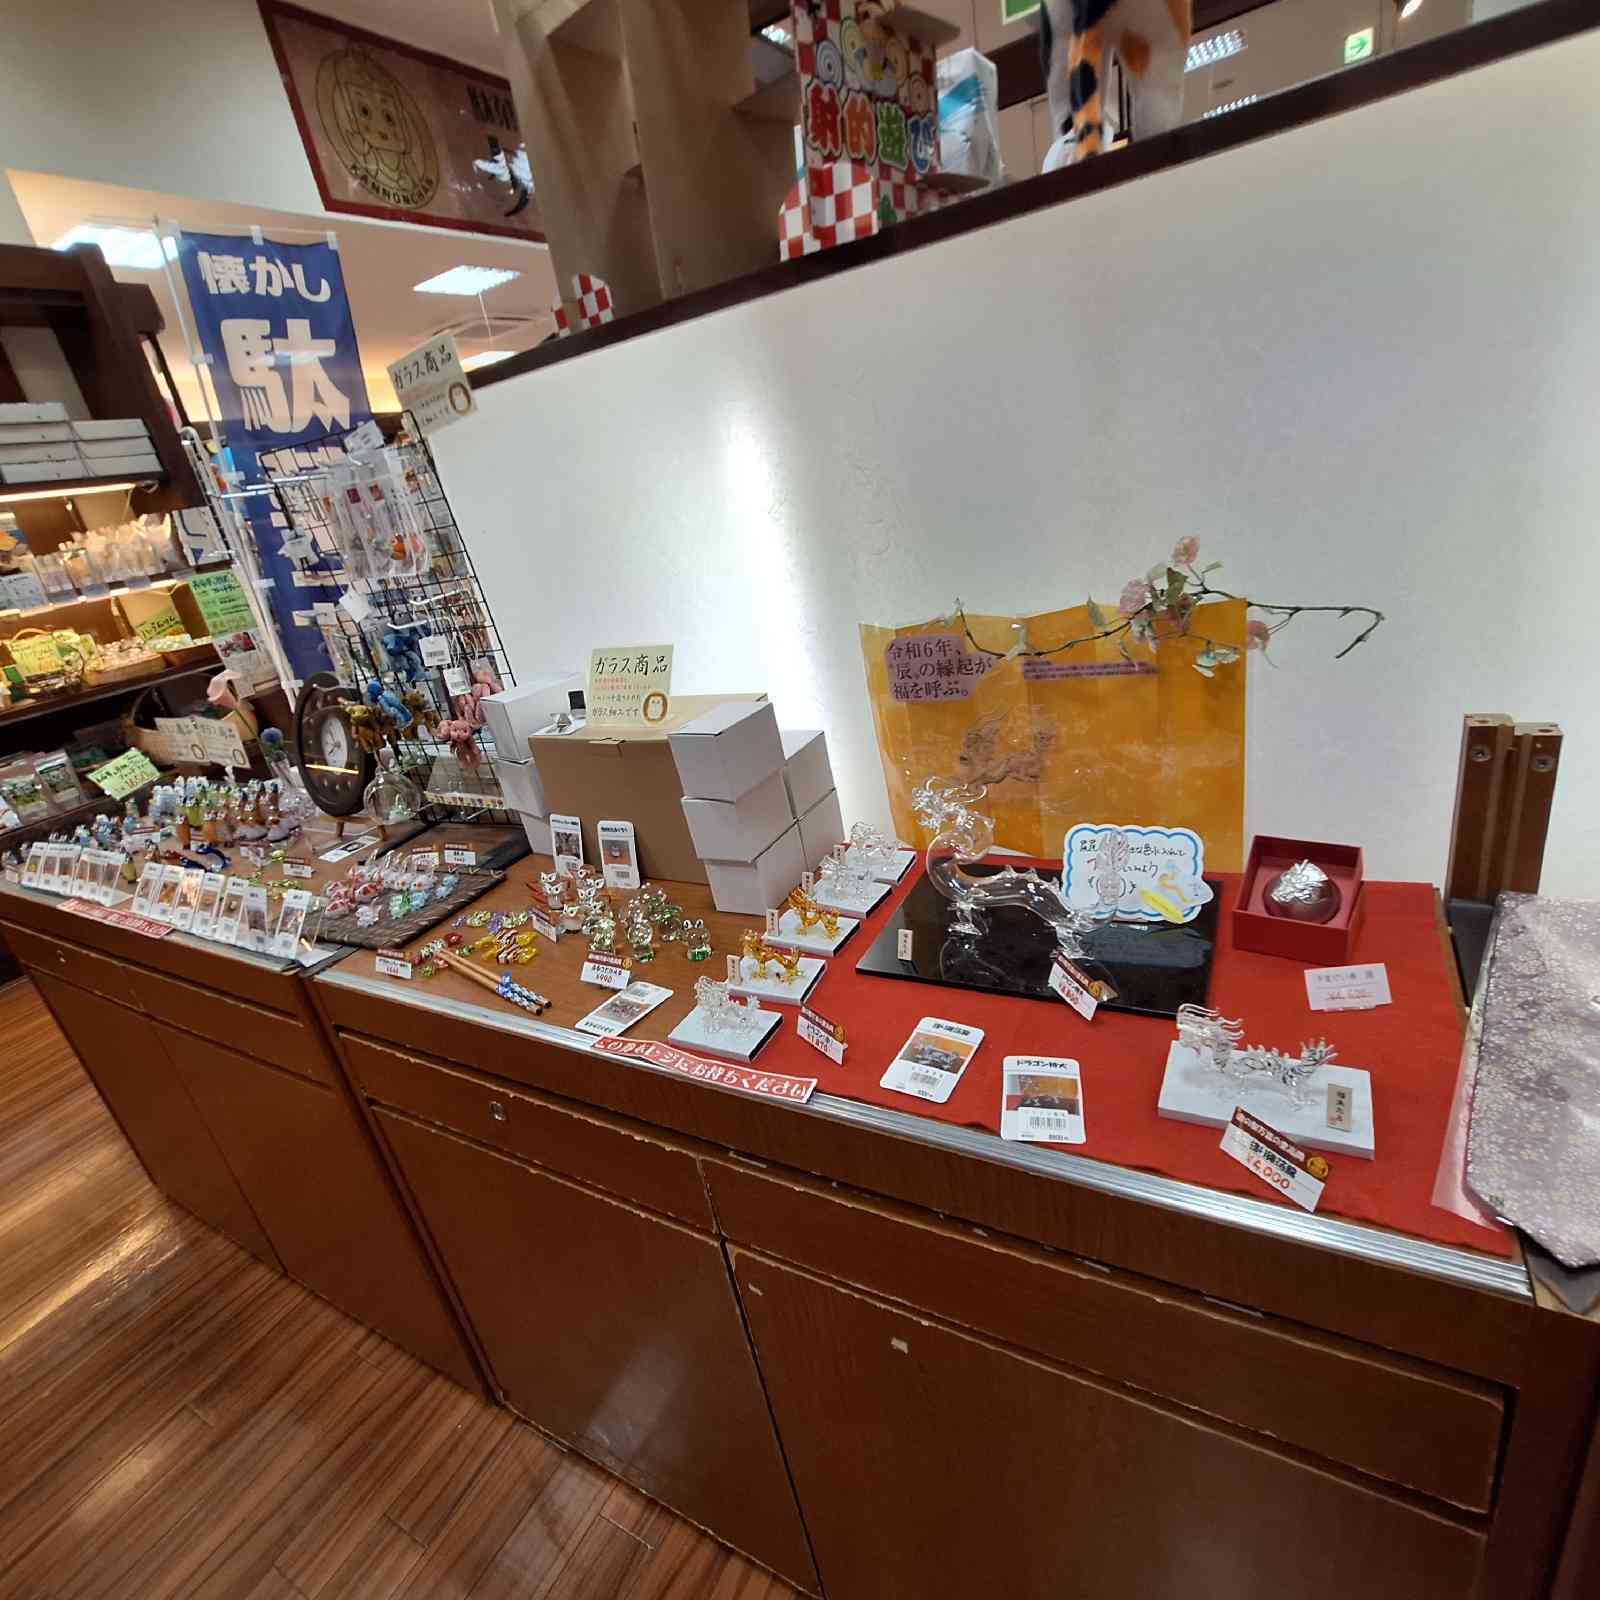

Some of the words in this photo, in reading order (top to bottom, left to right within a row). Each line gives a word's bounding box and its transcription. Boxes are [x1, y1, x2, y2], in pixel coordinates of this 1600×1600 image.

[197, 251, 331, 303] 懐かし
[594, 653, 668, 676] ガラス商品
[894, 680, 969, 700] 福を呼ぶ。
[1016, 1059, 1068, 1070] ドラゴン特大
